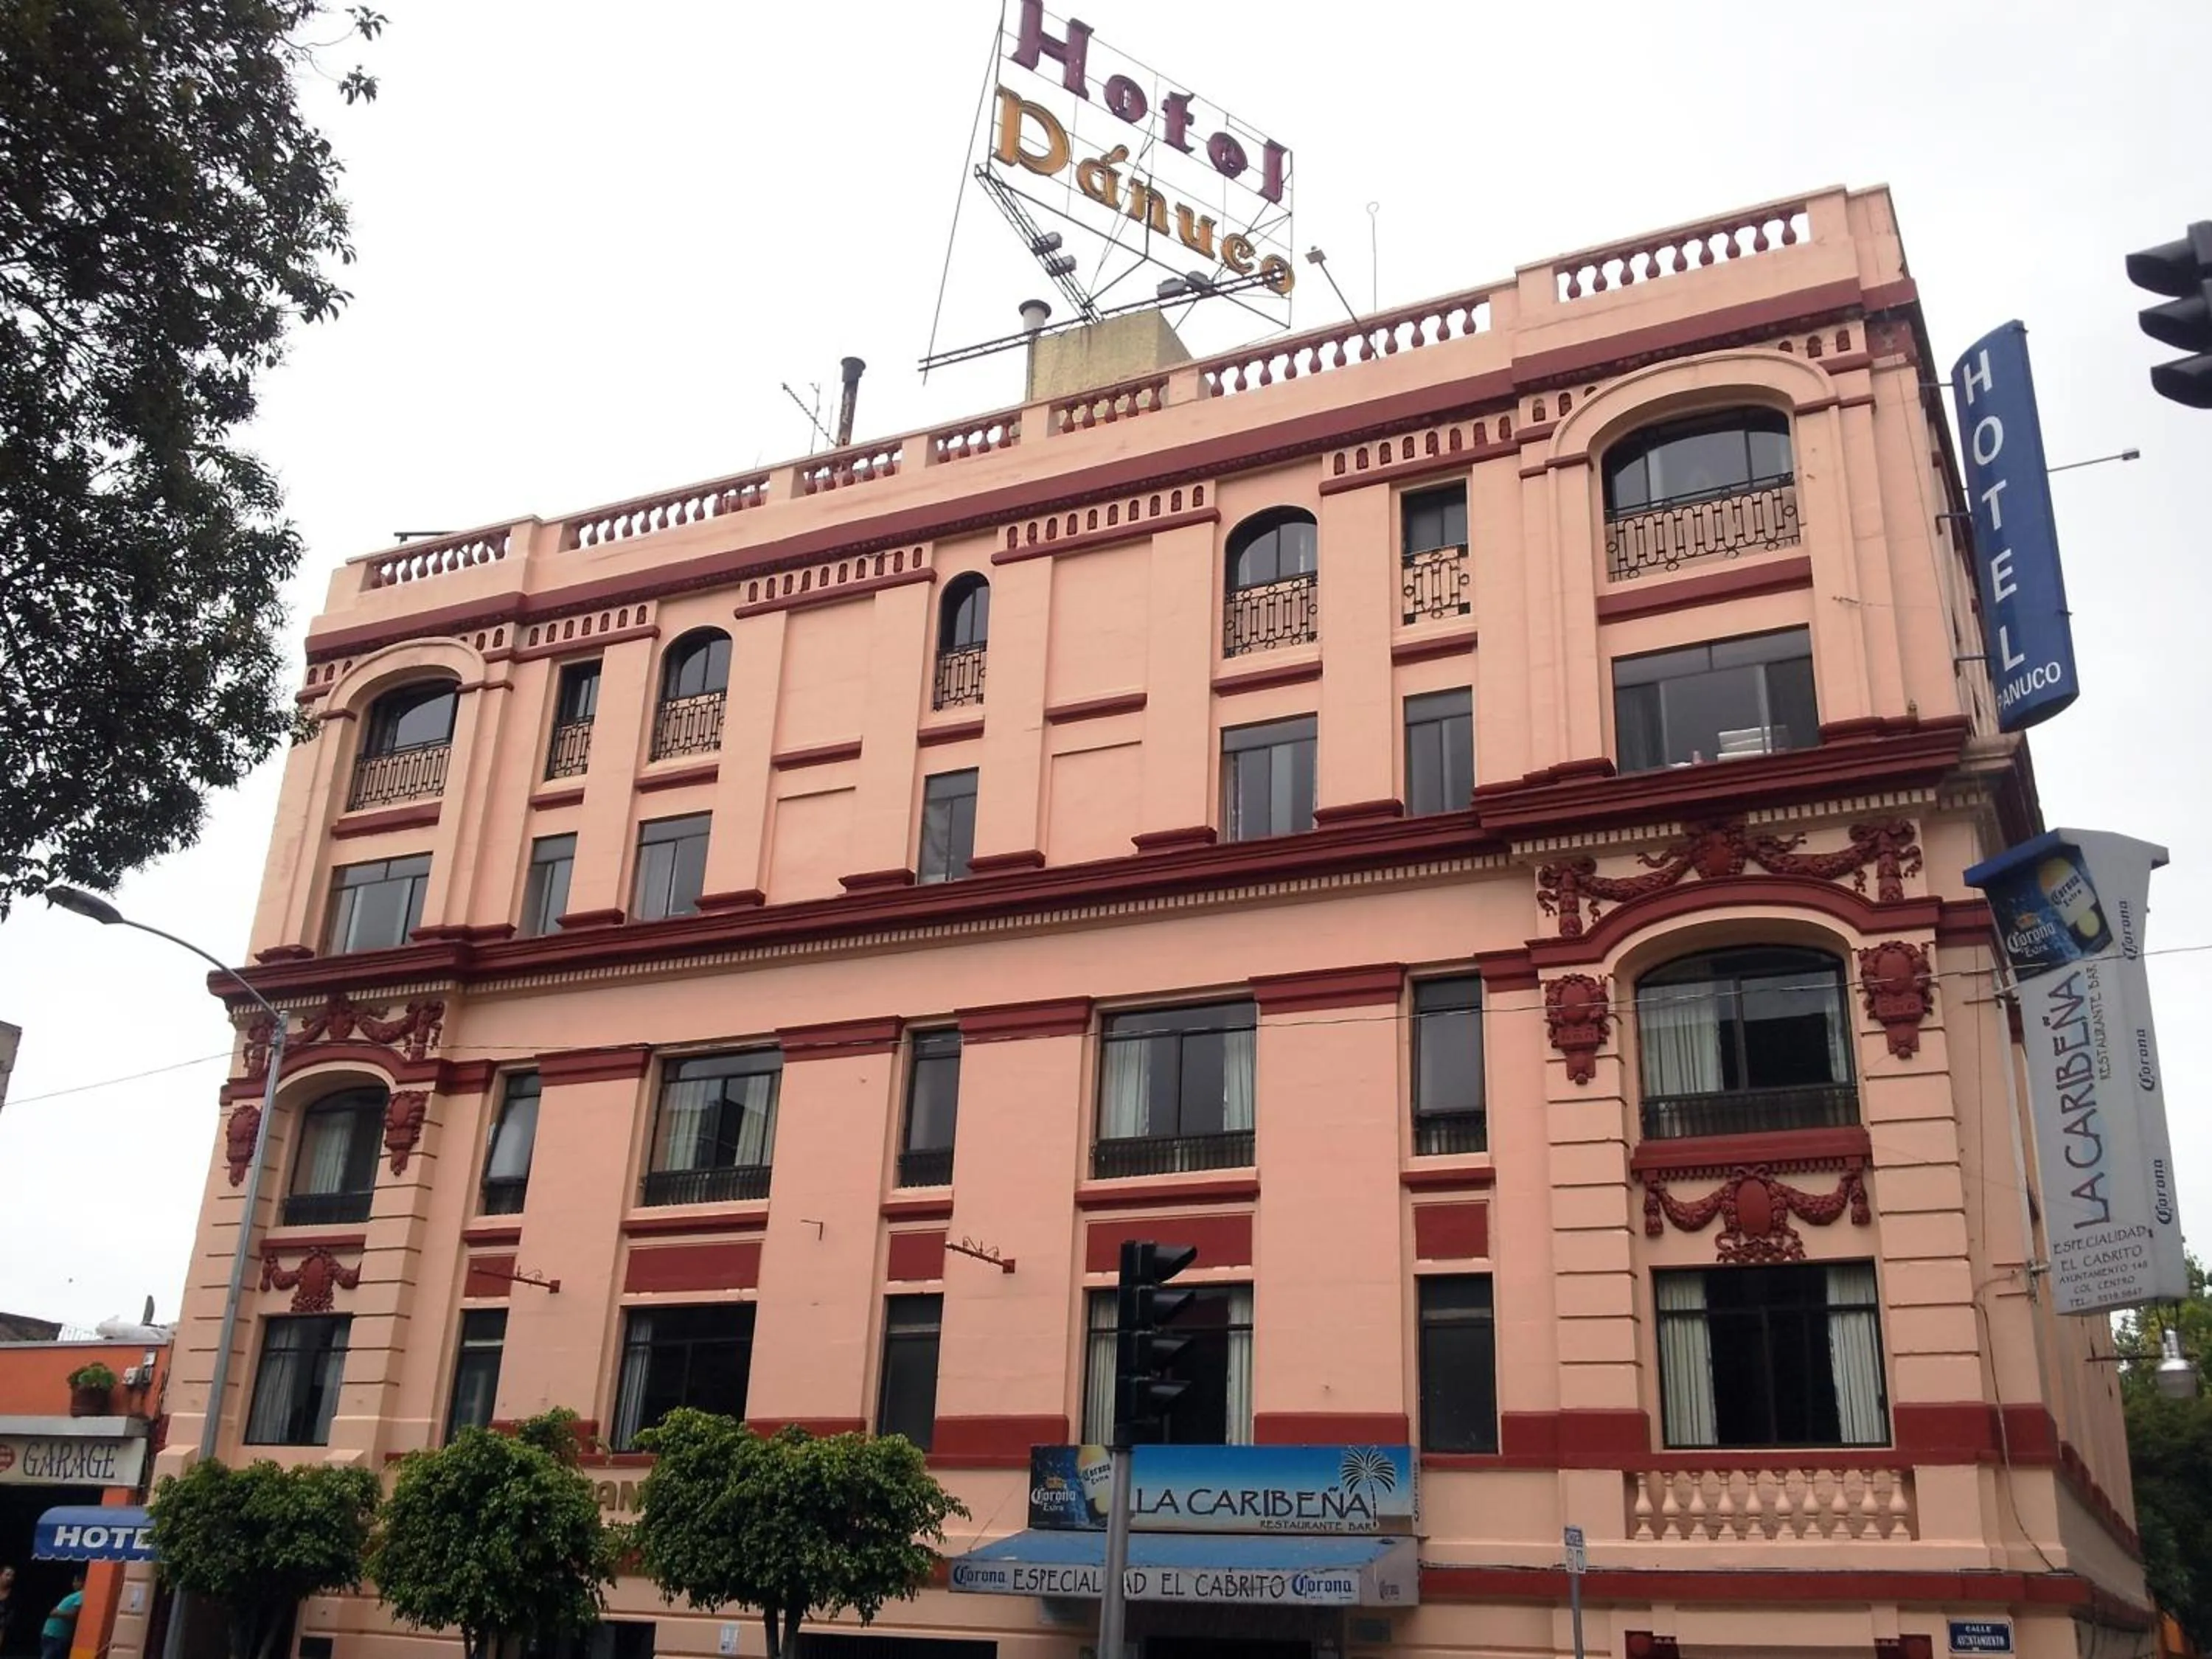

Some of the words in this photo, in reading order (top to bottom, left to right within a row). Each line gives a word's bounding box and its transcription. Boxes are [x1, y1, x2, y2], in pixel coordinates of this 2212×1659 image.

[1010, 0, 1289, 204] Hotel
[1963, 348, 2025, 672] HOTEL
[2007, 922, 2056, 953] Corona
[2118, 900, 2138, 960] Corona
[2042, 970, 2104, 1169] CARIBEÑA
[2136, 1029, 2155, 1091] Corona
[2070, 1171, 2111, 1229] LA
[2153, 1158, 2173, 1225] Corona
[2053, 1225, 2146, 1254] ESPECIALIDAD
[2061, 1258, 2078, 1272] EL
[2083, 1244, 2143, 1267] CABRITO
[23, 1441, 119, 1480] GARAGE
[1030, 1484, 1077, 1506] Corona
[1135, 1488, 1180, 1514] LA
[1186, 1485, 1371, 1519] CARIBEÑA
[53, 1525, 152, 1550] HOTE
[1260, 1520, 1343, 1531] RESTAURANTE
[1349, 1522, 1372, 1532] BAR
[953, 1564, 1006, 1585] Corona
[1013, 1568, 1147, 1594] ESPECIALAD
[1161, 1573, 1185, 1596] EL
[1194, 1572, 1286, 1599] CABRITO
[1292, 1573, 1352, 1599] Corona
